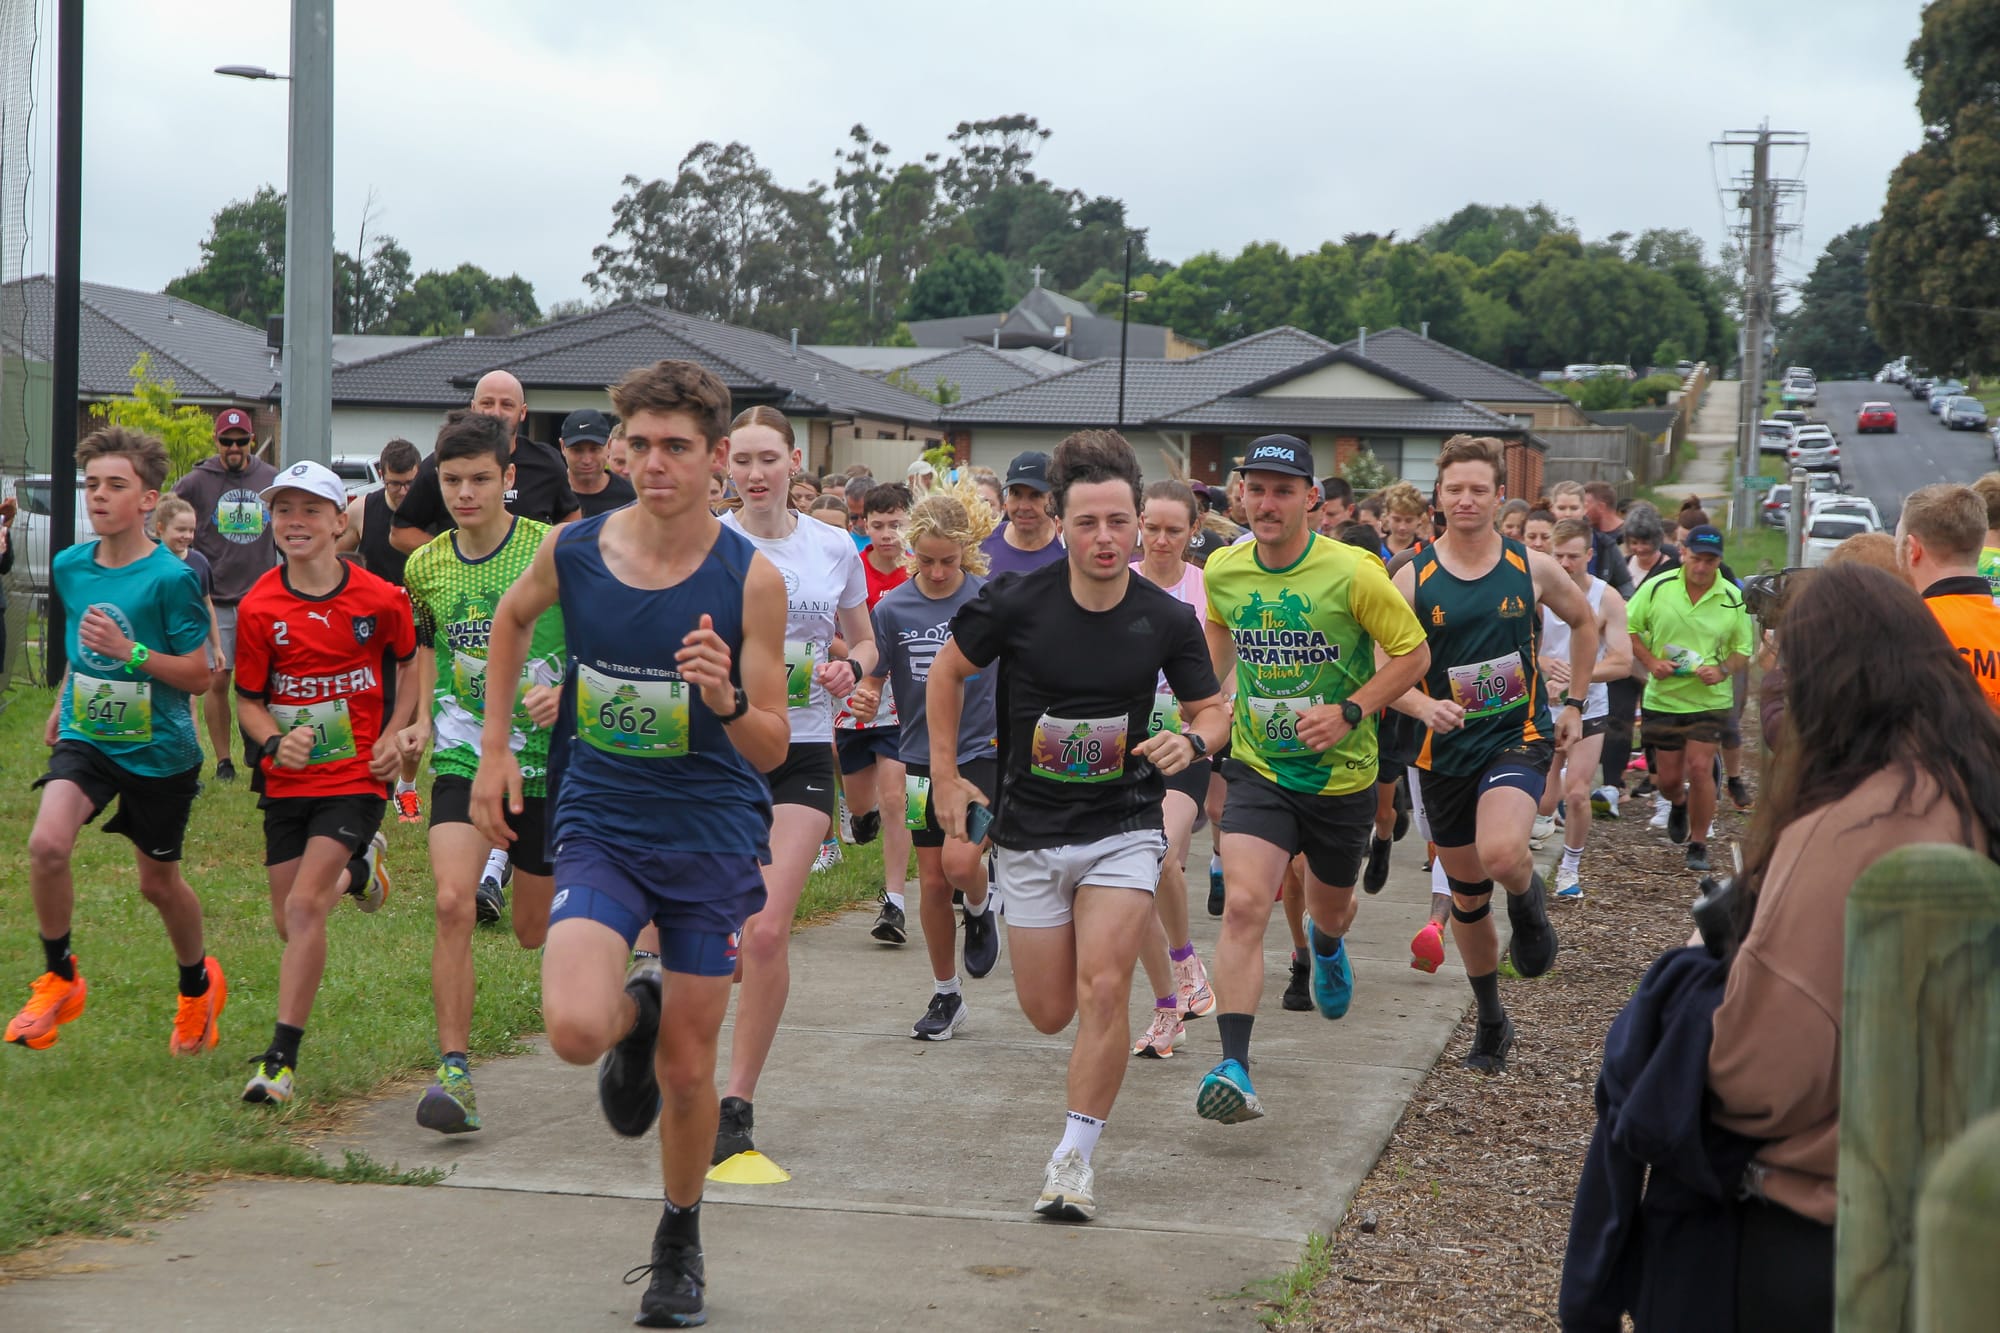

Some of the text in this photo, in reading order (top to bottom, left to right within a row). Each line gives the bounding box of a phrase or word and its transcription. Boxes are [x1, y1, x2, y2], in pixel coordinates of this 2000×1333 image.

[1253, 446, 1295, 462] HOKA
[1260, 610, 1285, 630] the
[273, 621, 289, 645] 2
[272, 666, 377, 698] WESTERN
[1471, 676, 1507, 702] 719
[86, 698, 128, 723] 647
[600, 702, 658, 735] 662
[1265, 718, 1299, 740] 66
[1060, 739, 1102, 764] 718
